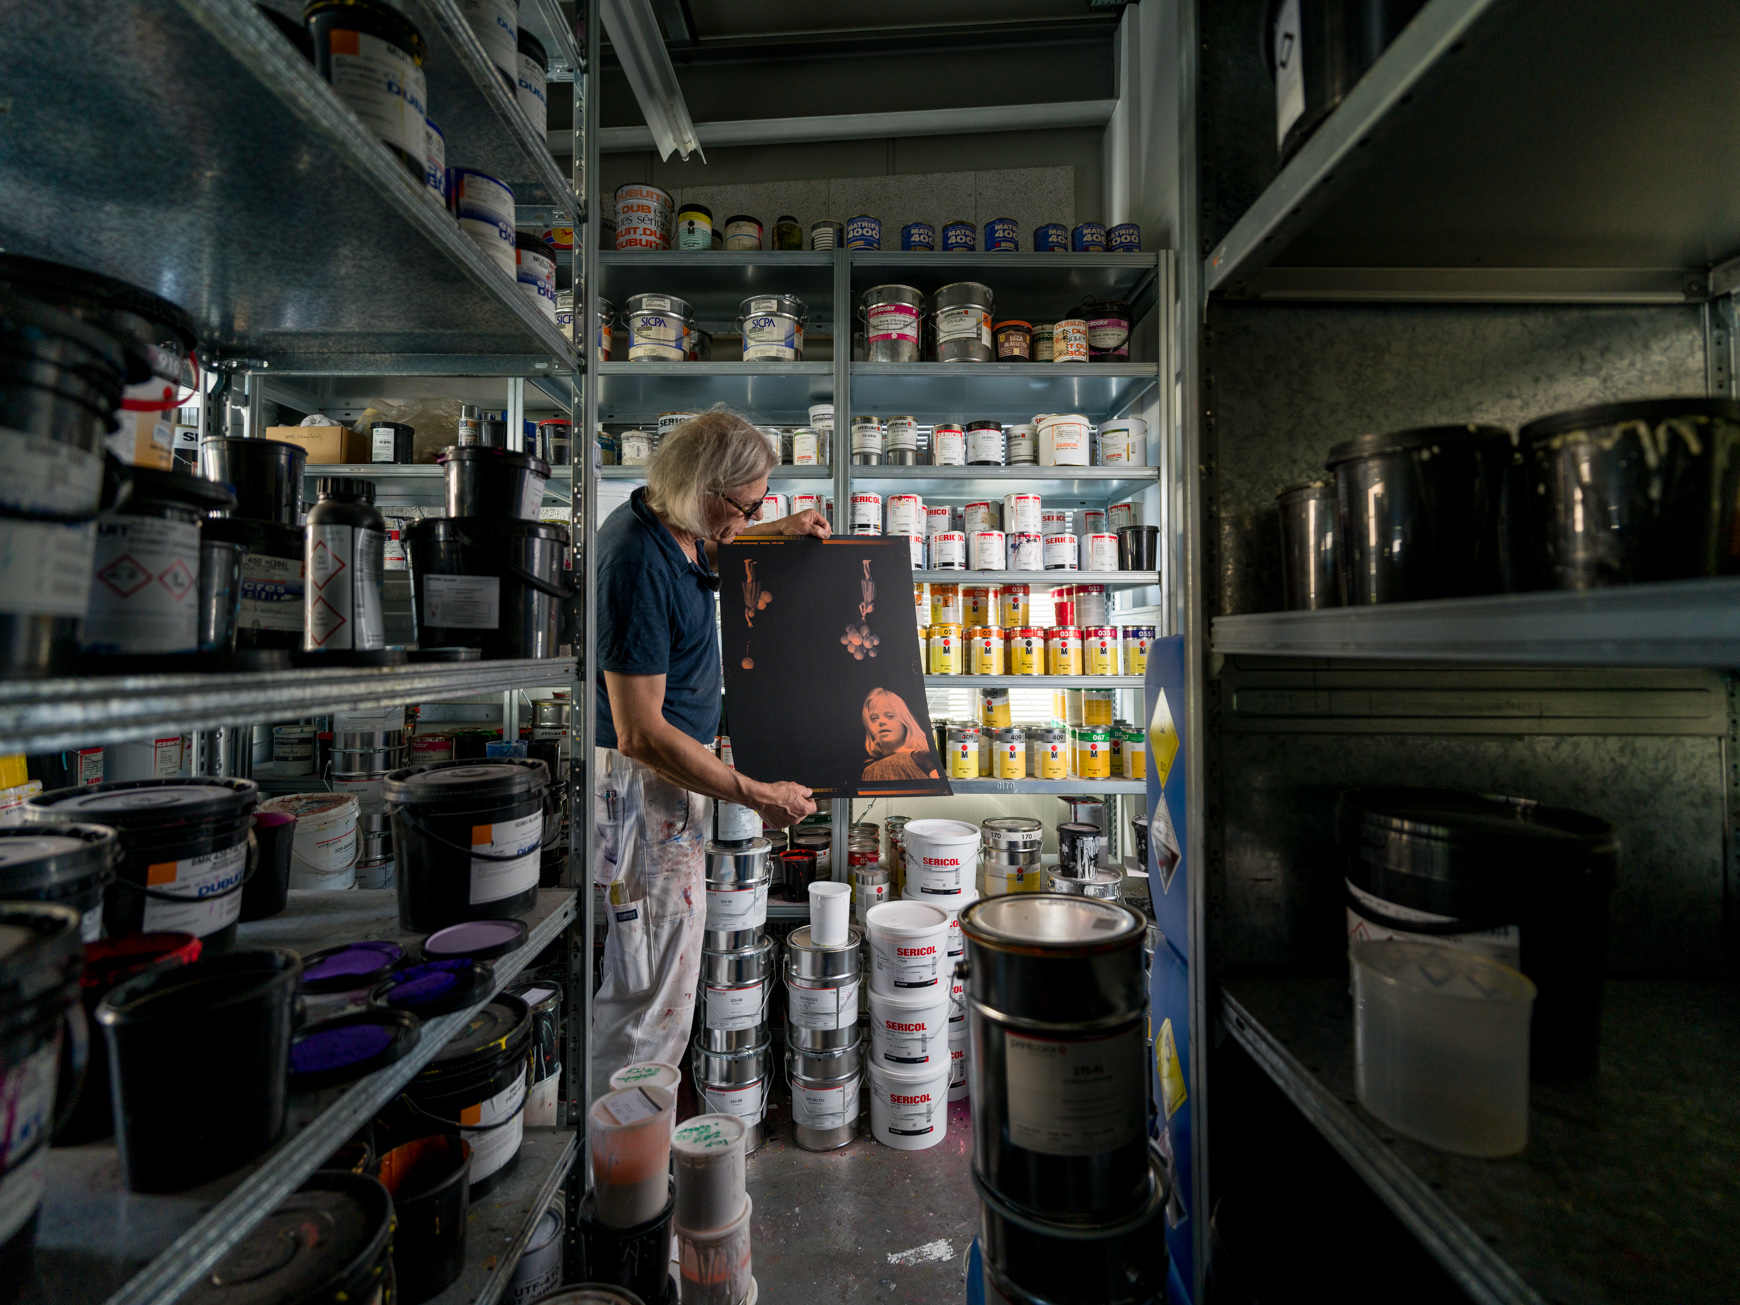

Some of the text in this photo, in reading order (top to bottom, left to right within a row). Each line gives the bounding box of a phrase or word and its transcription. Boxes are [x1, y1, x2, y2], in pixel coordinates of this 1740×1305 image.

[622, 204, 652, 214] DUB
[641, 316, 667, 327] SICPA
[753, 318, 776, 328] SICPA
[850, 496, 881, 504] SERICOL
[934, 534, 965, 542] SERICOL
[1045, 537, 1076, 545] SERICOL
[923, 857, 960, 866] SERICOL
[897, 946, 937, 956] SERICOL
[885, 1020, 927, 1032] SERICOL
[890, 1094, 932, 1104] SERICOL
